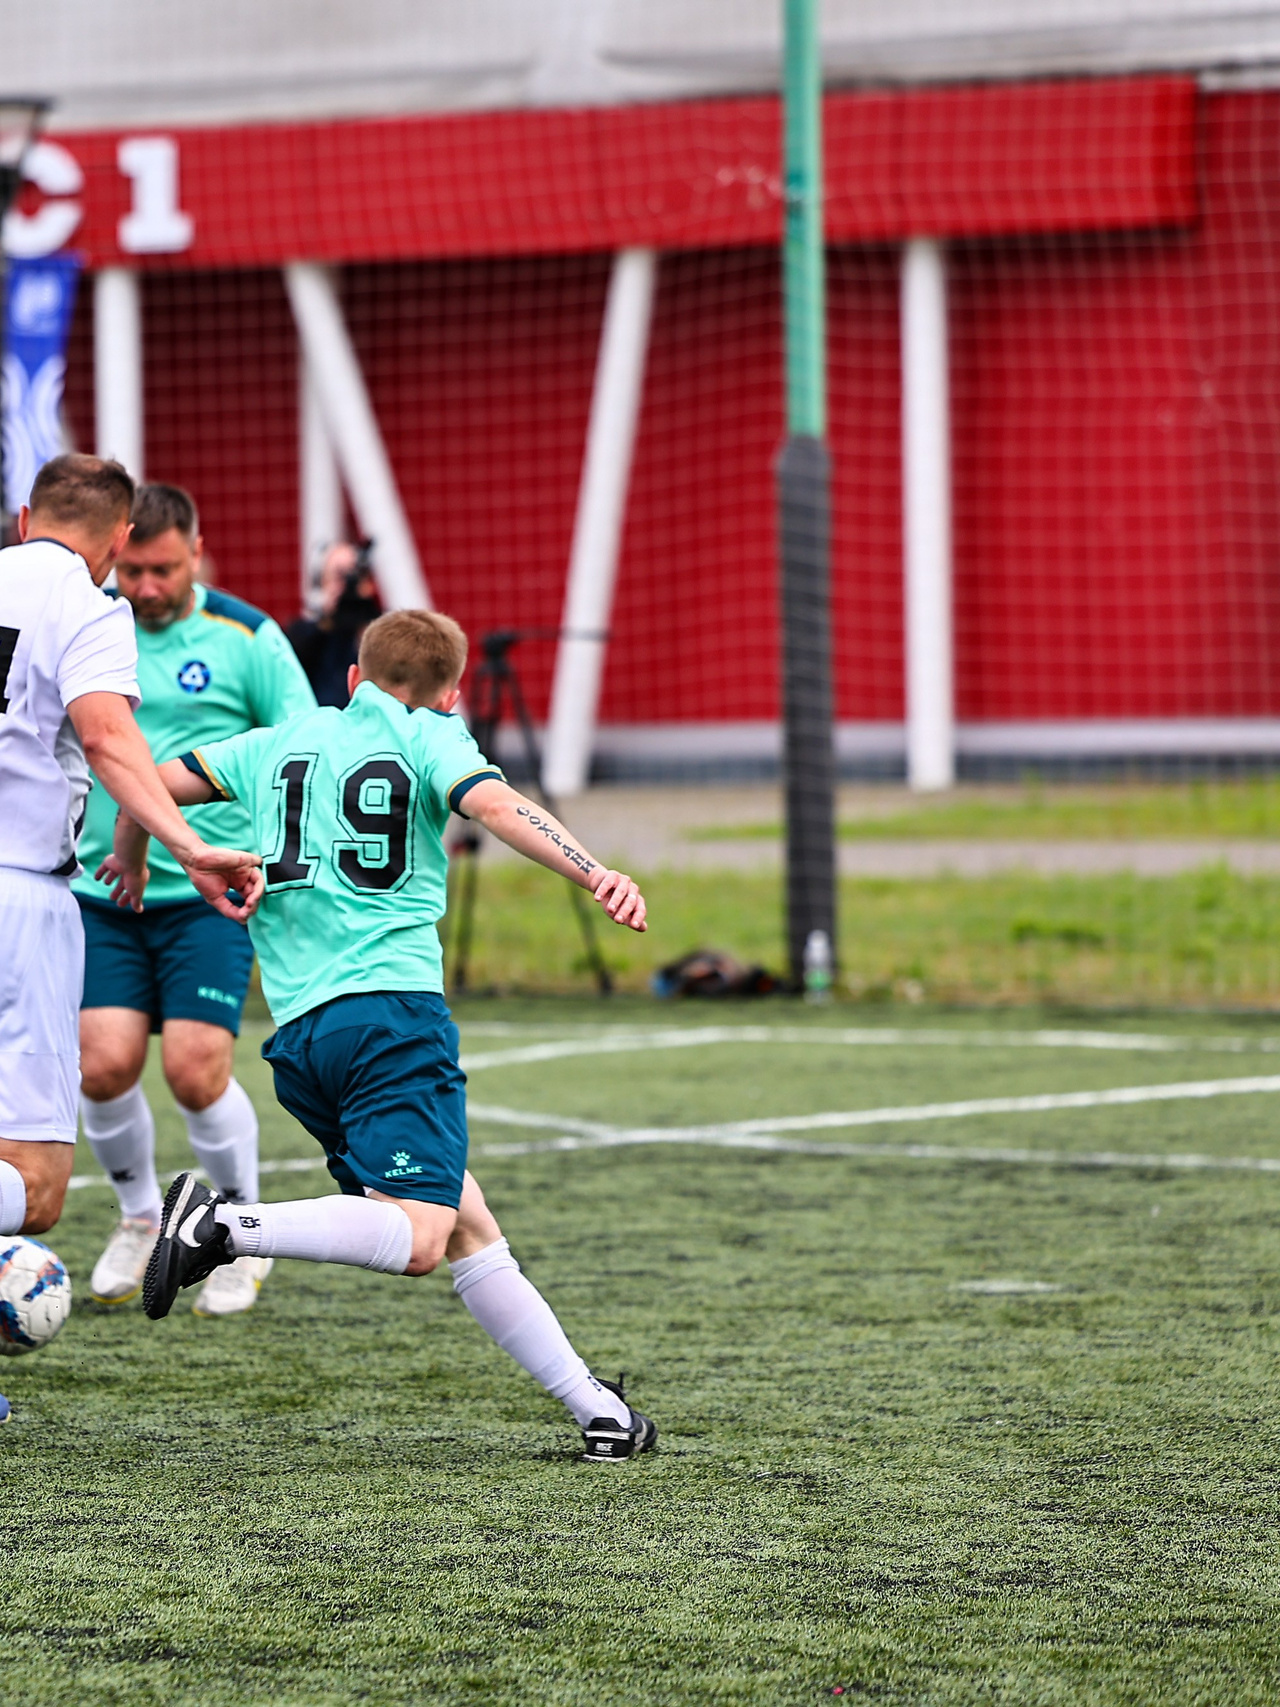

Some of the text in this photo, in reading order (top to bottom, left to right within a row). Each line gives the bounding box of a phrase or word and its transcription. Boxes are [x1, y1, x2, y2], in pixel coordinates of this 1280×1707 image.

[117, 137, 194, 254] 1
[261, 751, 420, 896] 19
[516, 806, 597, 876] СОХРАНИ
[384, 1165, 423, 1179] KELME
